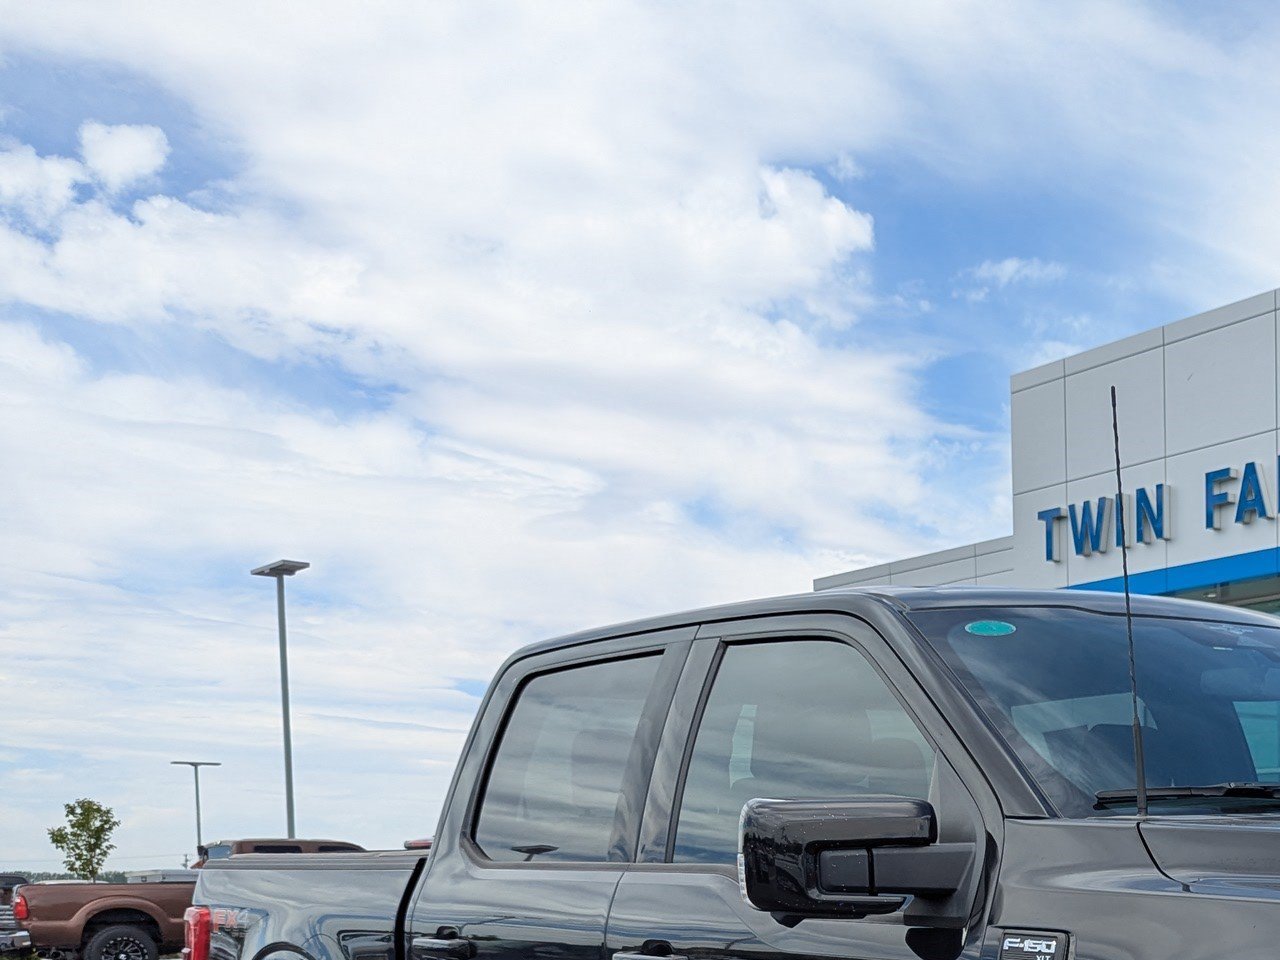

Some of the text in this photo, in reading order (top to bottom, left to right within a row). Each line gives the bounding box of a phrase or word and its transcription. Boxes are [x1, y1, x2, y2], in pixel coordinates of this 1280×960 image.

[1037, 483, 1170, 562] TWIN
[213, 908, 249, 932] FX4
[1003, 938, 1057, 954] F-150
